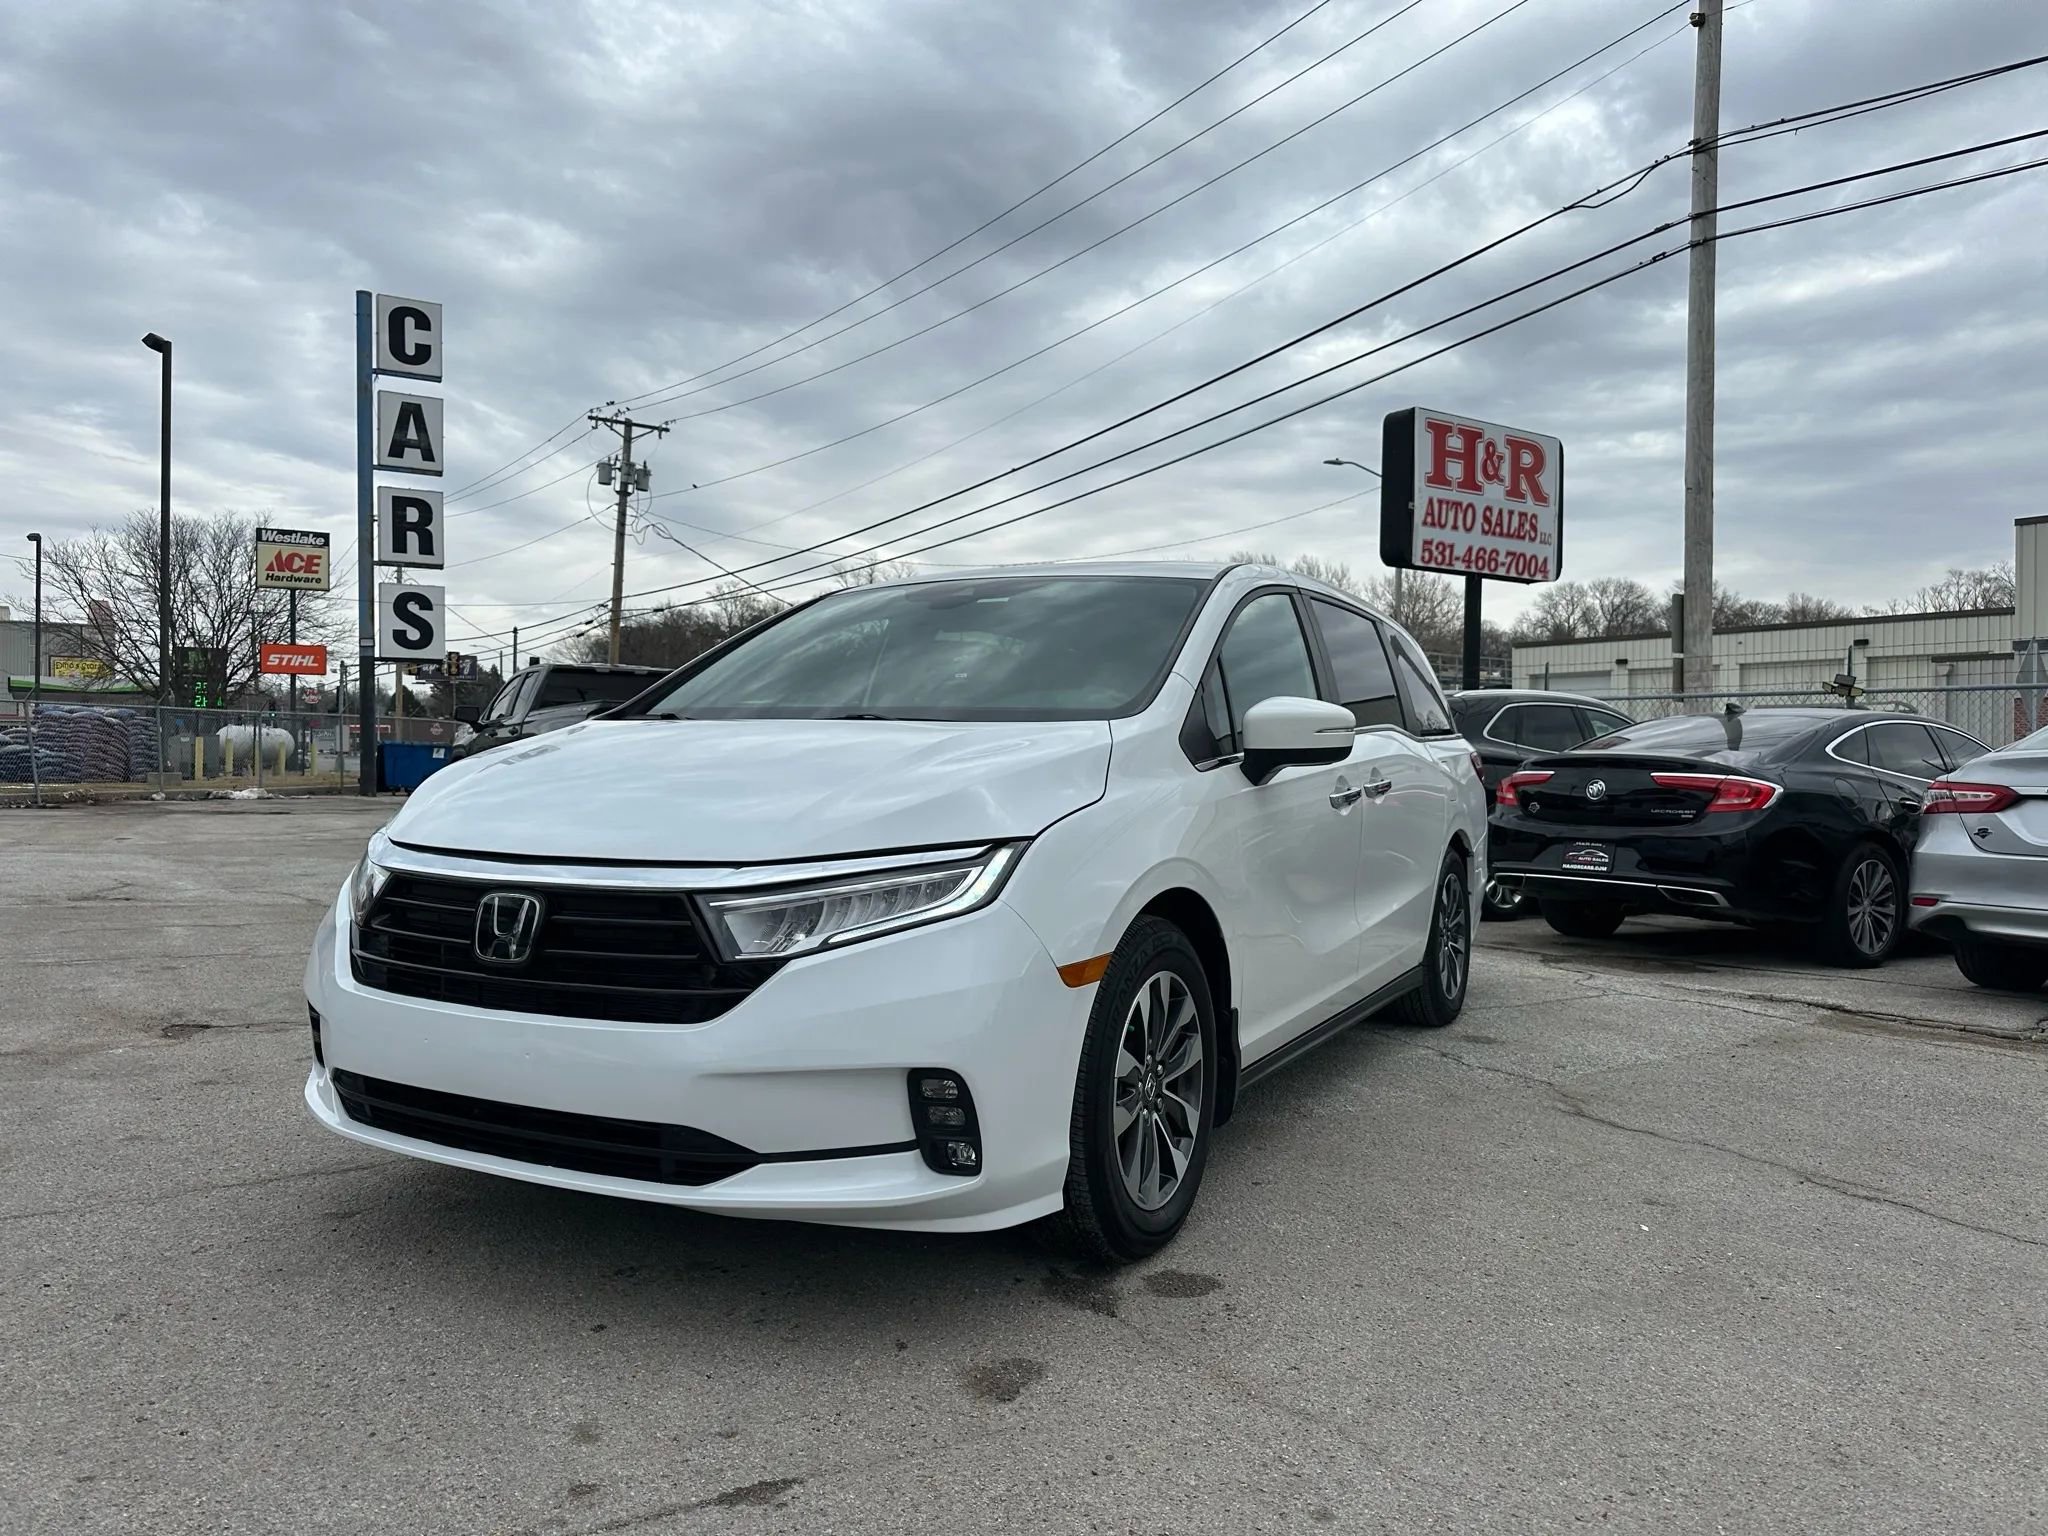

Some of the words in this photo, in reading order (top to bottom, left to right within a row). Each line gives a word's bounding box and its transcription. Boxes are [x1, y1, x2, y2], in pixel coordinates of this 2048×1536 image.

[387, 305, 434, 650] CARS
[1425, 418, 1549, 507] H&R
[261, 530, 325, 546] Westlake
[1422, 497, 1476, 532] AUTO
[1481, 504, 1538, 543] SALES
[1539, 532, 1552, 546] LLC
[265, 549, 322, 574] ACE
[1420, 538, 1549, 580] 531-466-7004
[265, 573, 322, 585] Hardware
[267, 653, 318, 667] STIHL
